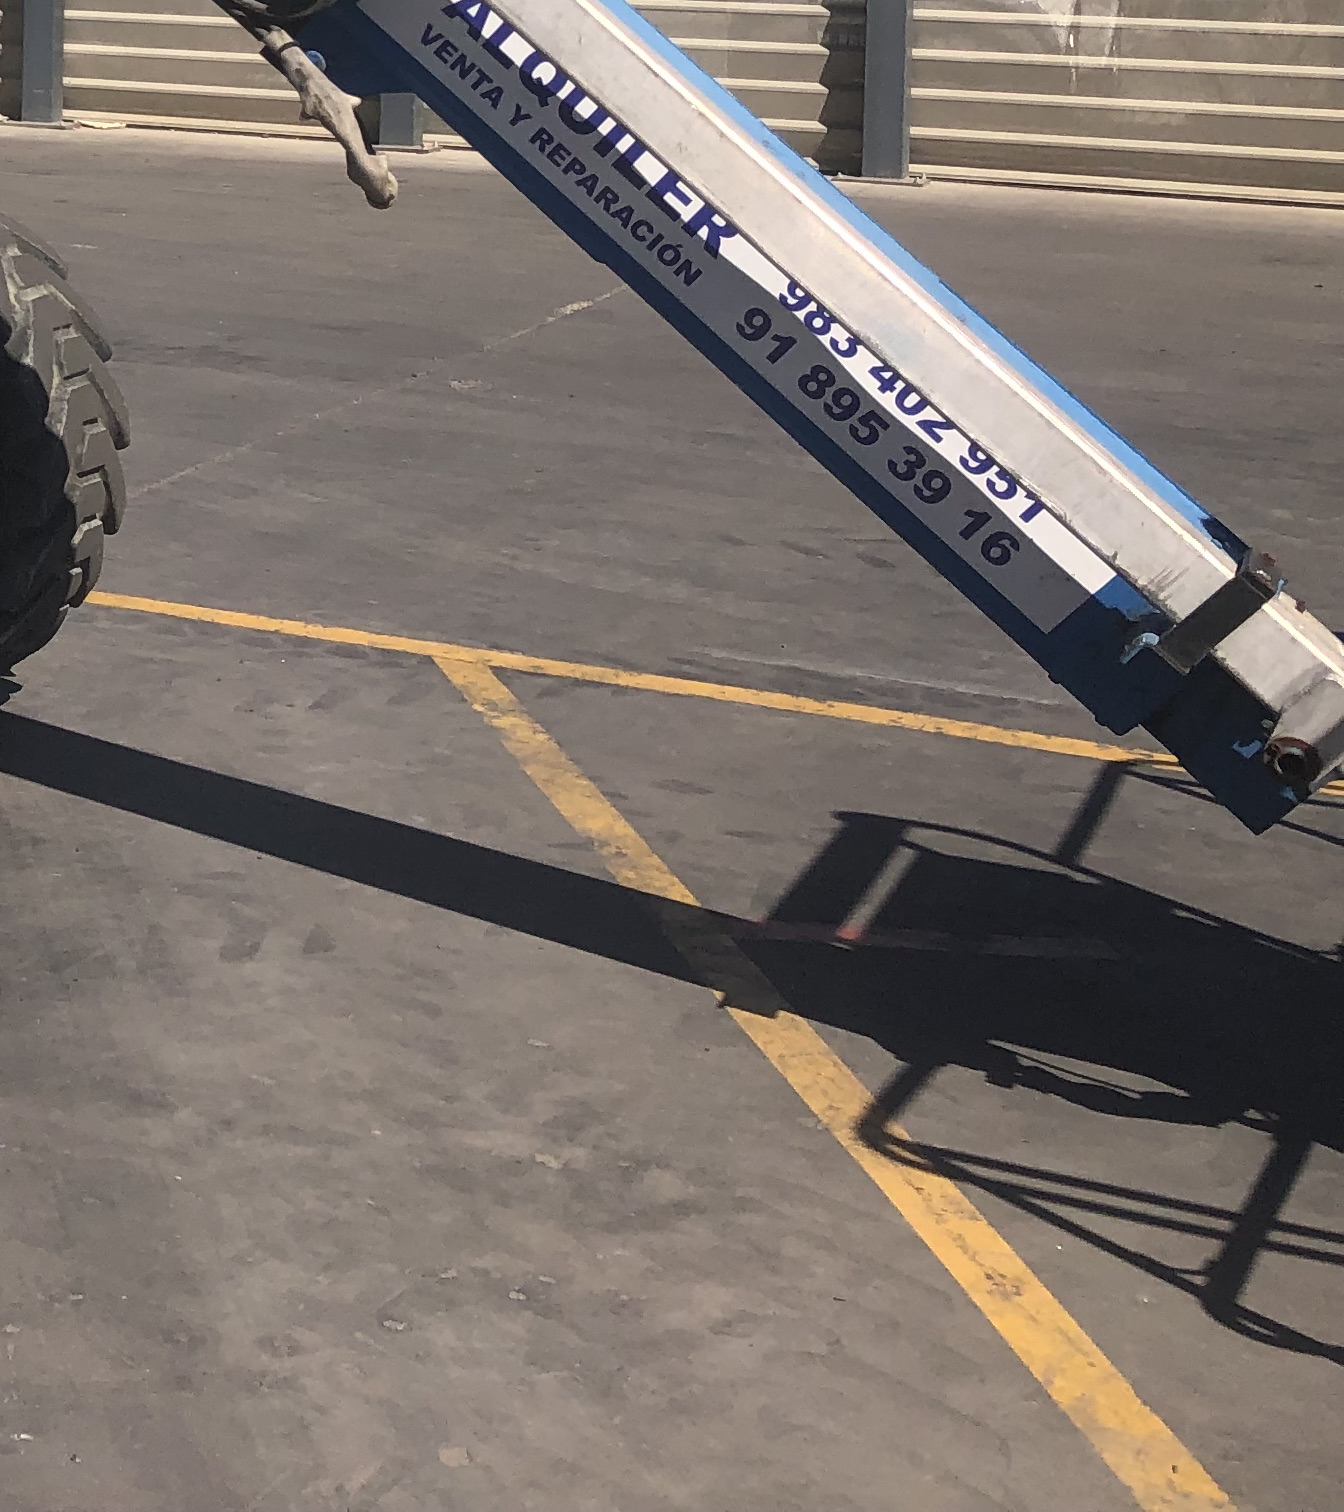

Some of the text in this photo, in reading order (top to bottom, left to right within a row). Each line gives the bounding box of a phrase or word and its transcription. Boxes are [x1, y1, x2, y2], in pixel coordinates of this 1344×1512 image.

[420, 23, 704, 287] VENTA Y REPARACIÓN
[736, 307, 1021, 566] 91 895 39 16
[778, 279, 863, 358] 983
